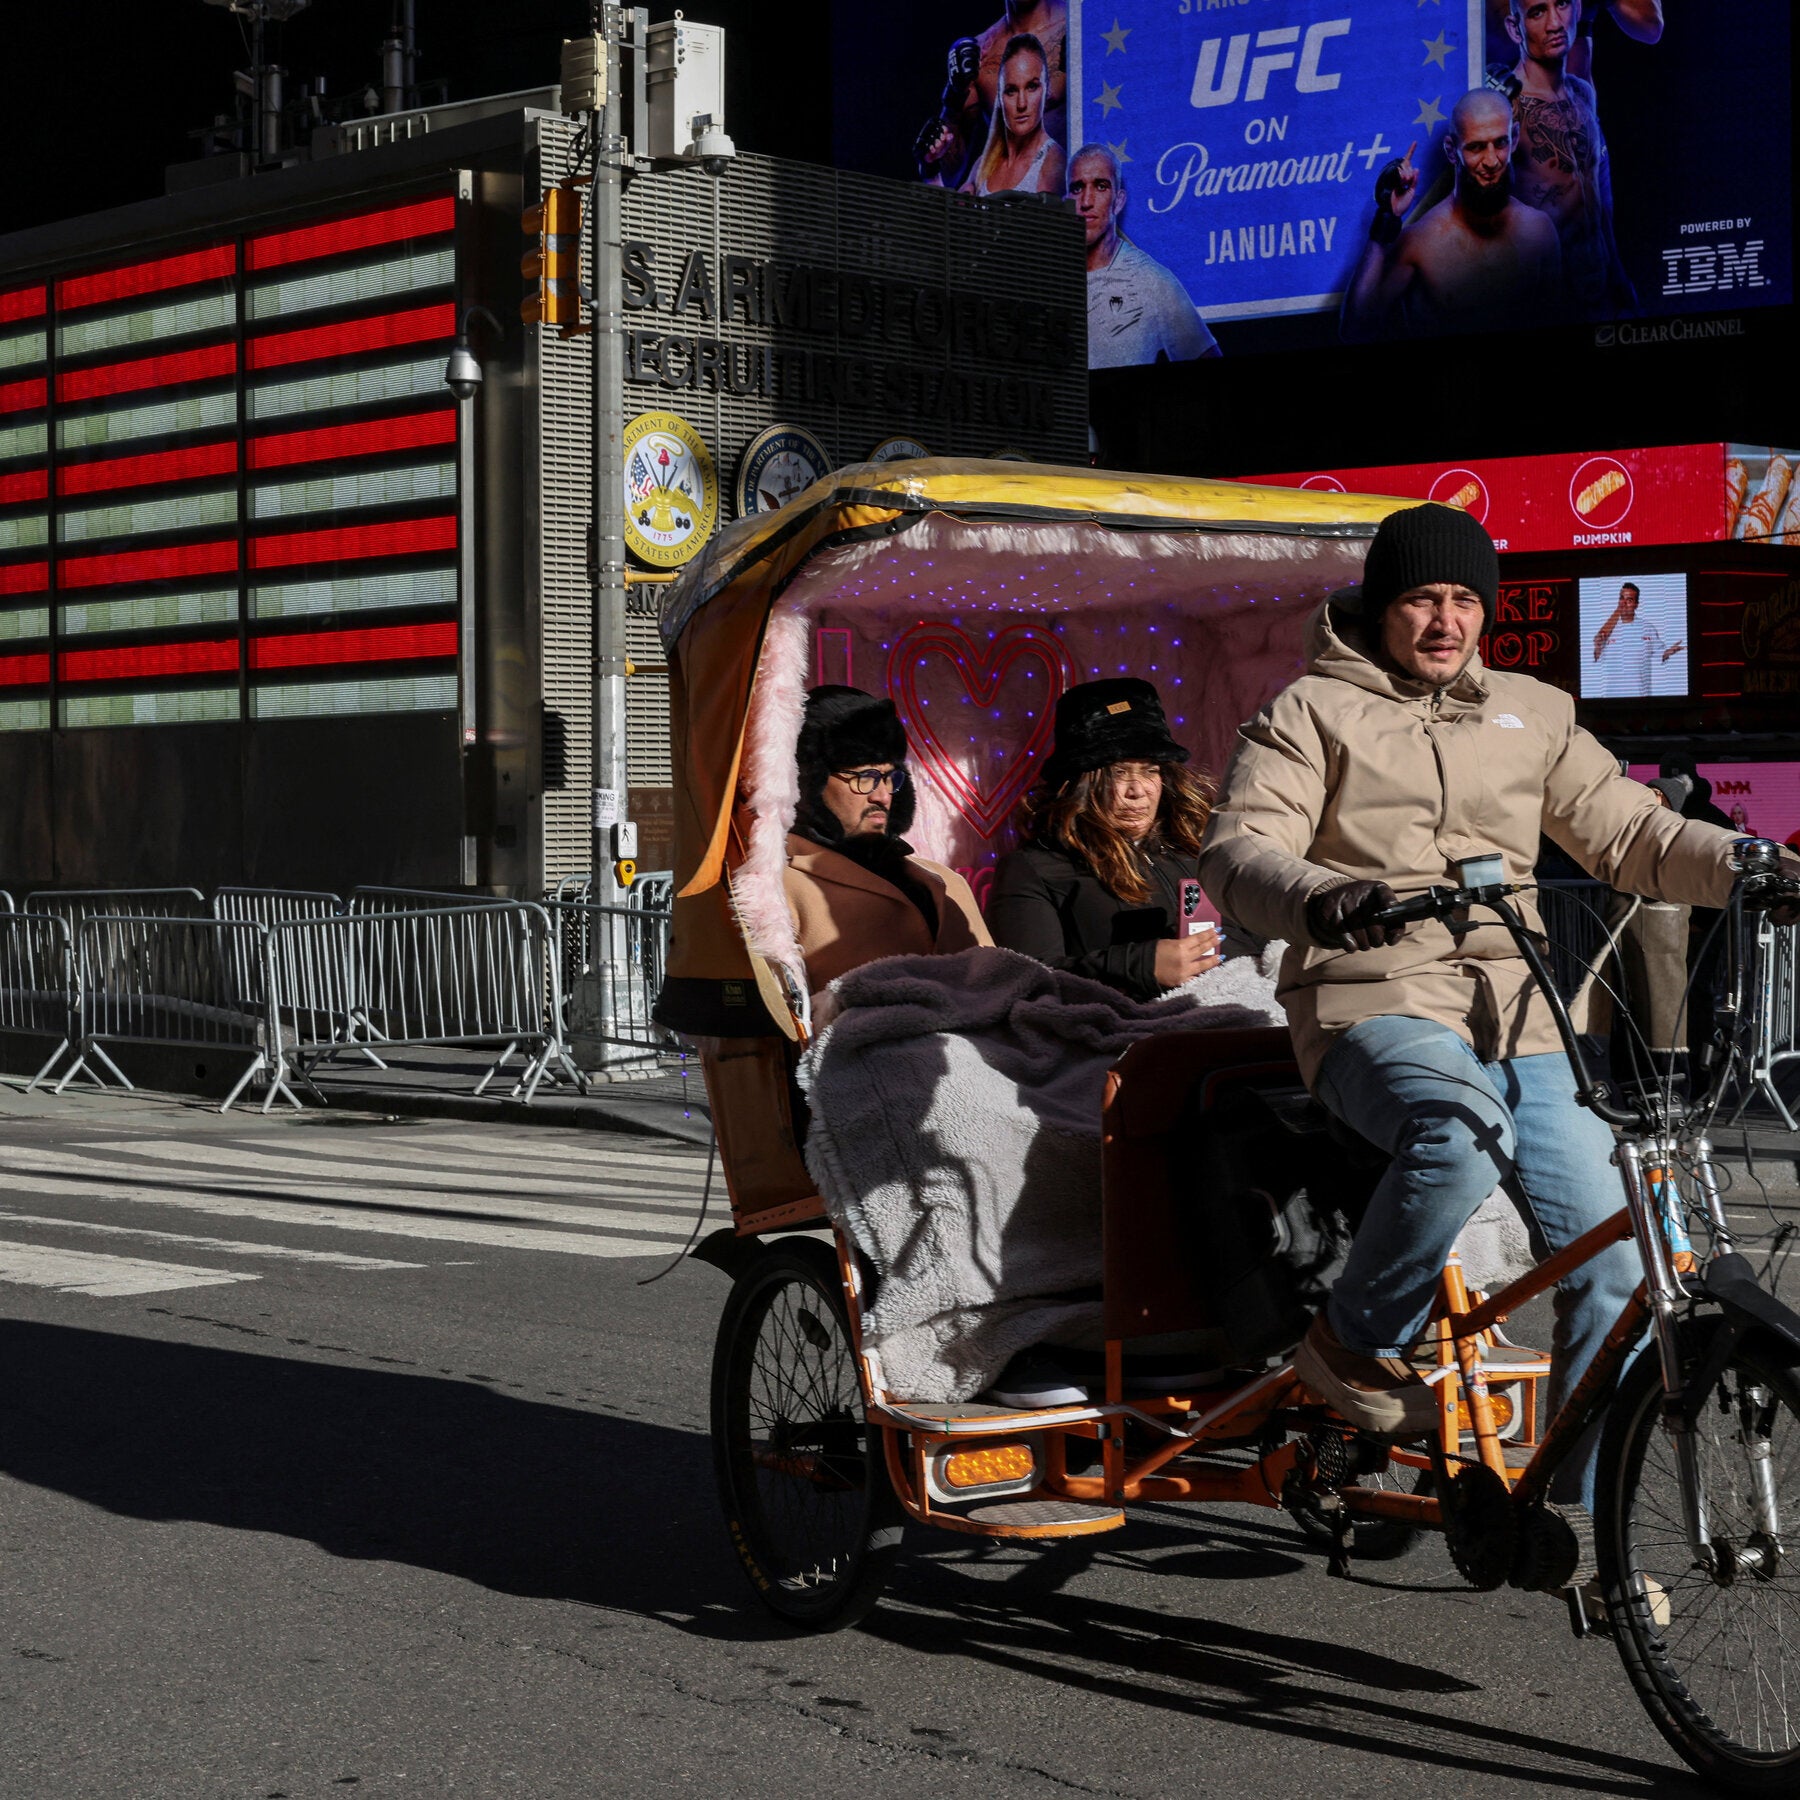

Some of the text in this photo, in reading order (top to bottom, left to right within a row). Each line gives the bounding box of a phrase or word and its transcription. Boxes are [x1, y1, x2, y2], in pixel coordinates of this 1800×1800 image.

[1190, 18, 1351, 108] UFC
[1244, 115, 1288, 145] ON
[1148, 133, 1391, 213] Paramount+
[1204, 216, 1337, 265] JANUARY
[1680, 217, 1751, 235] POWERED BY
[1662, 240, 1765, 295] IBM
[624, 419, 663, 451] ARTMENT
[668, 420, 680, 432] OF
[683, 430, 698, 450] THE
[748, 438, 786, 492] DEPARTMENT
[788, 439, 799, 449] OF
[634, 503, 712, 560] STATES OF AMERICA
[653, 532, 673, 541] 1775
[1573, 532, 1632, 545] PUMPKIN
[1496, 587, 1554, 622] KE
